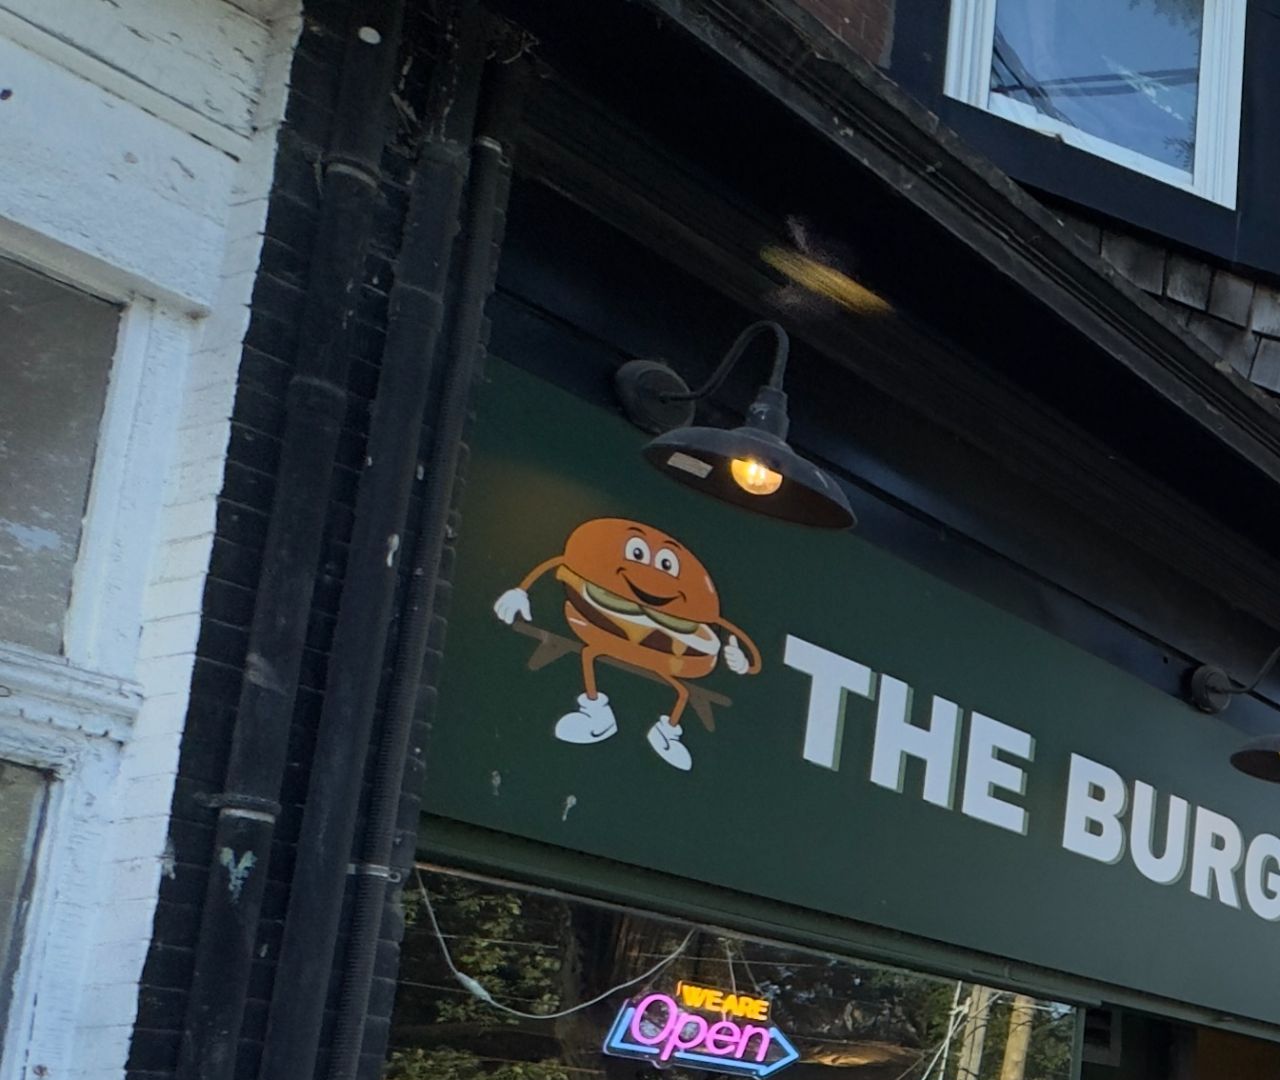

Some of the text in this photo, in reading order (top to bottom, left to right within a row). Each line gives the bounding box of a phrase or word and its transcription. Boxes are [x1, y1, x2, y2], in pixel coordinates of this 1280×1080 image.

[783, 633, 1036, 836] THE
[631, 993, 771, 1061] Open
[722, 996, 770, 1021] ARE
